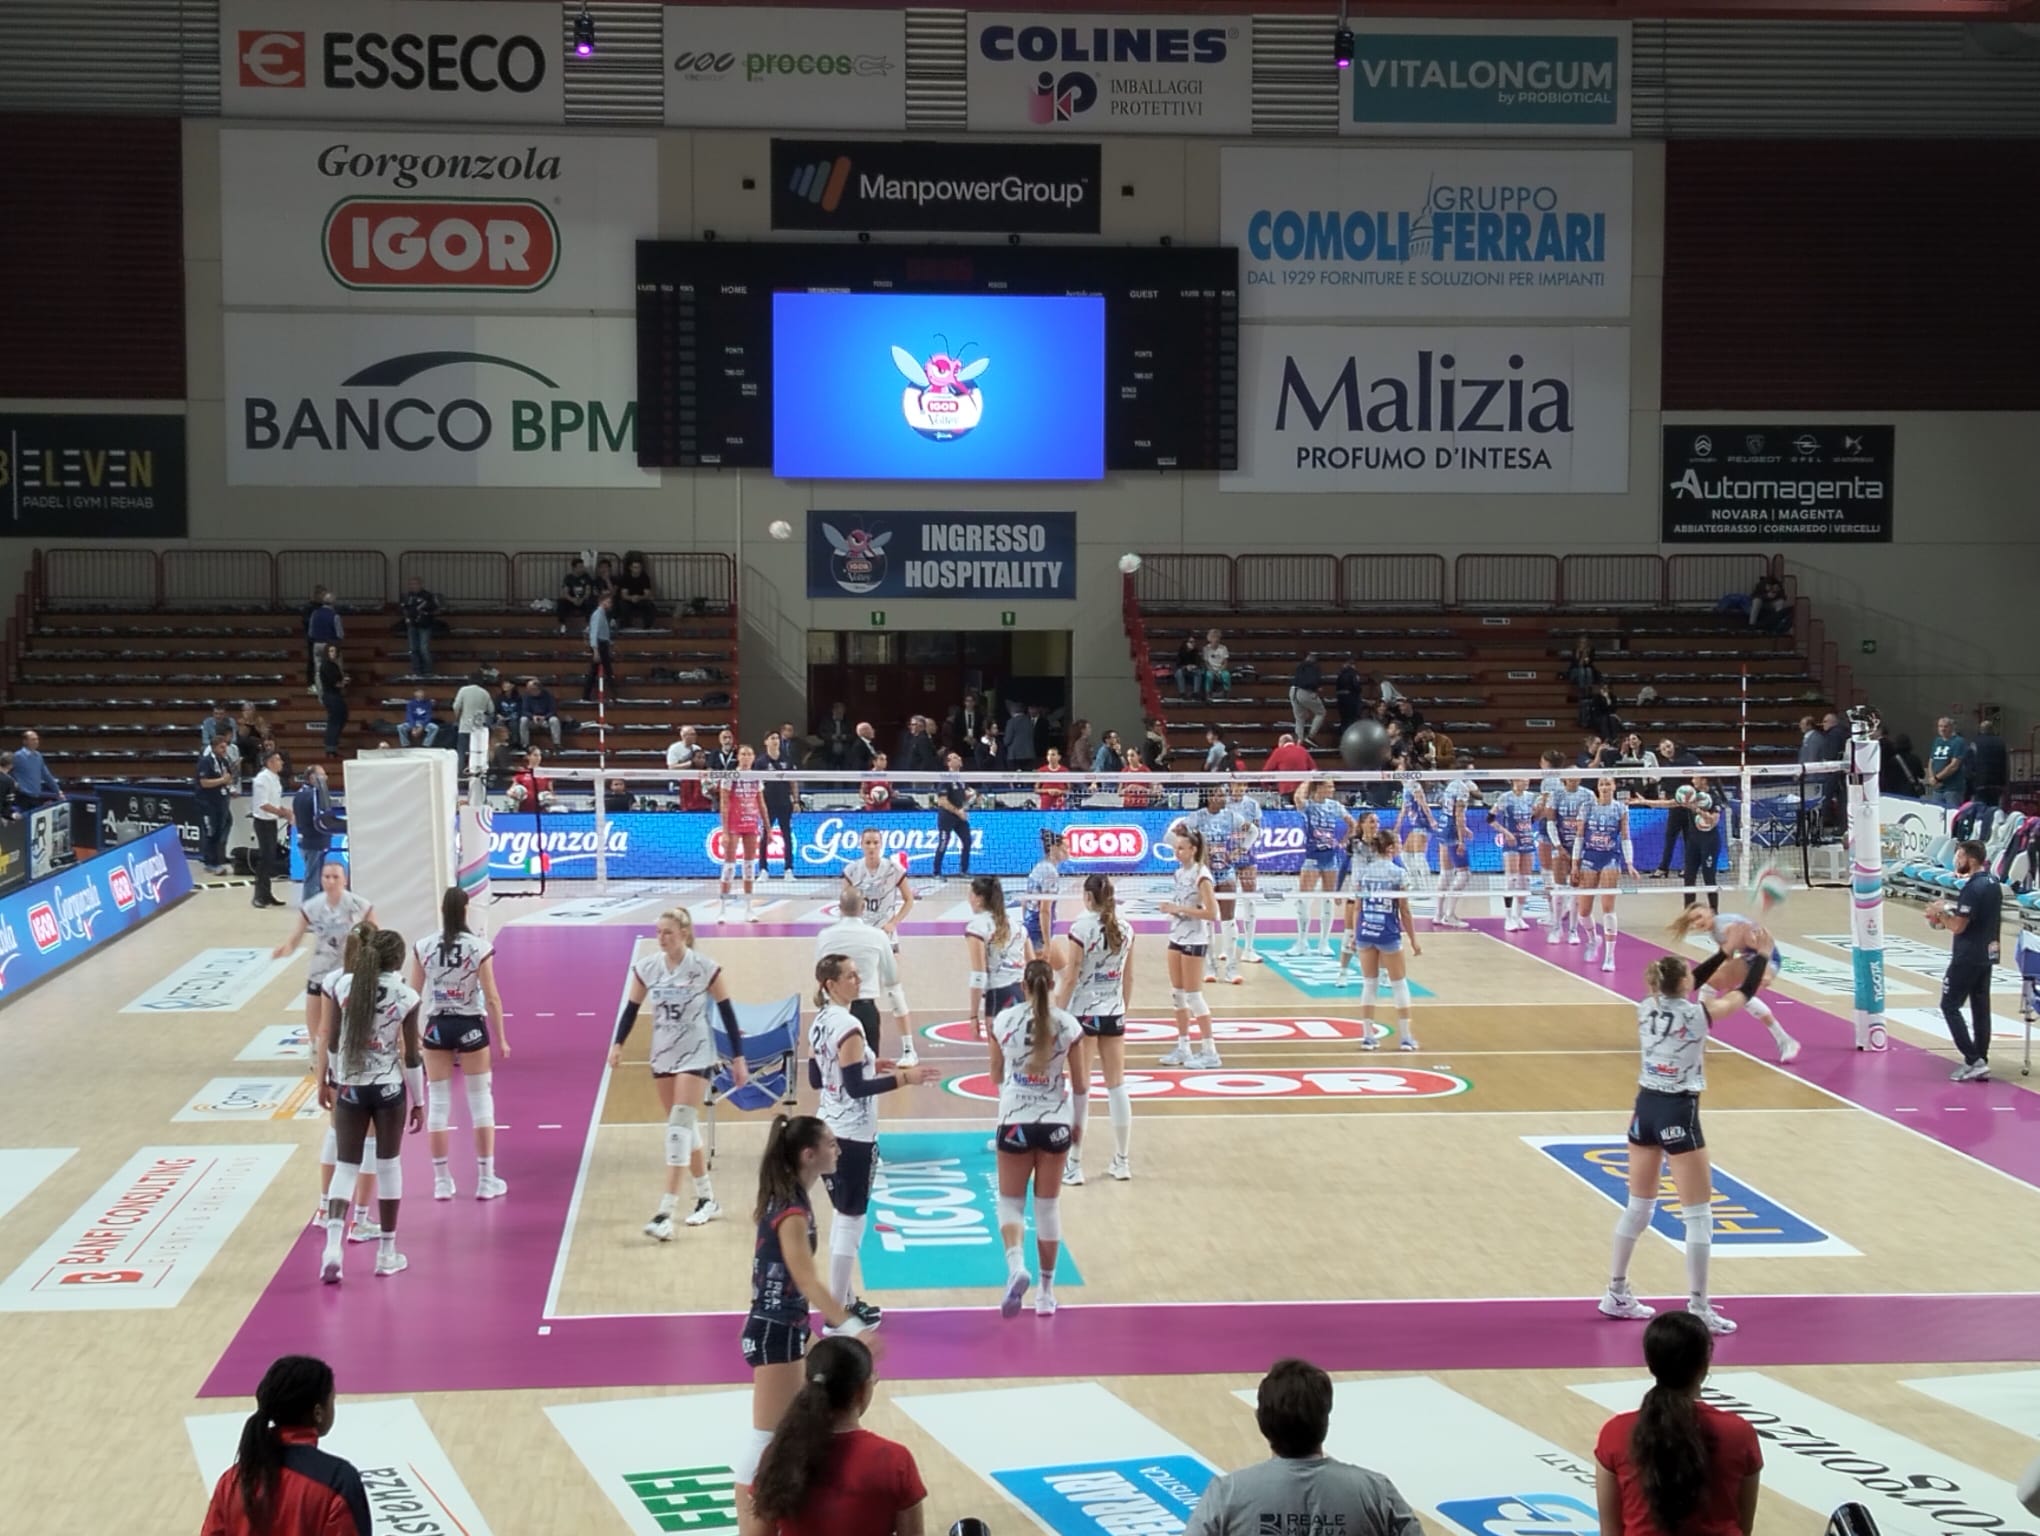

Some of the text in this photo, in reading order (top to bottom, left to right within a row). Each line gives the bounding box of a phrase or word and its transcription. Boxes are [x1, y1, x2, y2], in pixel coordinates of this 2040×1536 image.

[980, 25, 1227, 63] COLINES
[323, 32, 546, 92] ESSECO
[746, 53, 852, 82] procos
[1111, 79, 1202, 95] IMBALLAGGI
[1361, 60, 1612, 90] VITALONGUM
[1111, 101, 1202, 116] PROTETTIVI
[1499, 92, 1611, 105] by PROBIOTICAL
[317, 145, 562, 189] Gorgonzola
[860, 173, 1083, 207] ManpowerGroup
[1433, 186, 1558, 211] GRUPPO
[352, 217, 531, 272] IGOR
[1248, 209, 1605, 262] COMOLI FERRARI
[721, 284, 747, 294] HOME
[1247, 270, 1605, 287] DAL 1929 FORNITURE E SOLUZIONI PER IMPIANTI
[1130, 291, 1158, 299] GUEST
[1274, 350, 1574, 434] Malizia
[929, 401, 957, 411] IGOR
[245, 397, 637, 452] BANCO BPM
[1296, 446, 1552, 470] PROFUMO D'INTESA
[1670, 468, 1883, 505] Automagenta
[23, 497, 154, 509] PADEL GYM REHAB
[1711, 509, 1844, 520] NOVARA MAGENTA
[922, 524, 1046, 552] INGRESSO
[1673, 524, 1881, 533] ABBIATEGRASSO CORNAREDO VERCELLI
[905, 561, 1063, 588] HOSPITALITY
[1393, 771, 1422, 780] ESSECO
[1071, 831, 1140, 857] IGOR
[437, 943, 462, 968] 13
[663, 1003, 681, 1021] 15
[1648, 1010, 1675, 1037] 17
[56, 1158, 197, 1265] BANFI CONSULTING
[1287, 1514, 1346, 1526] REALE
